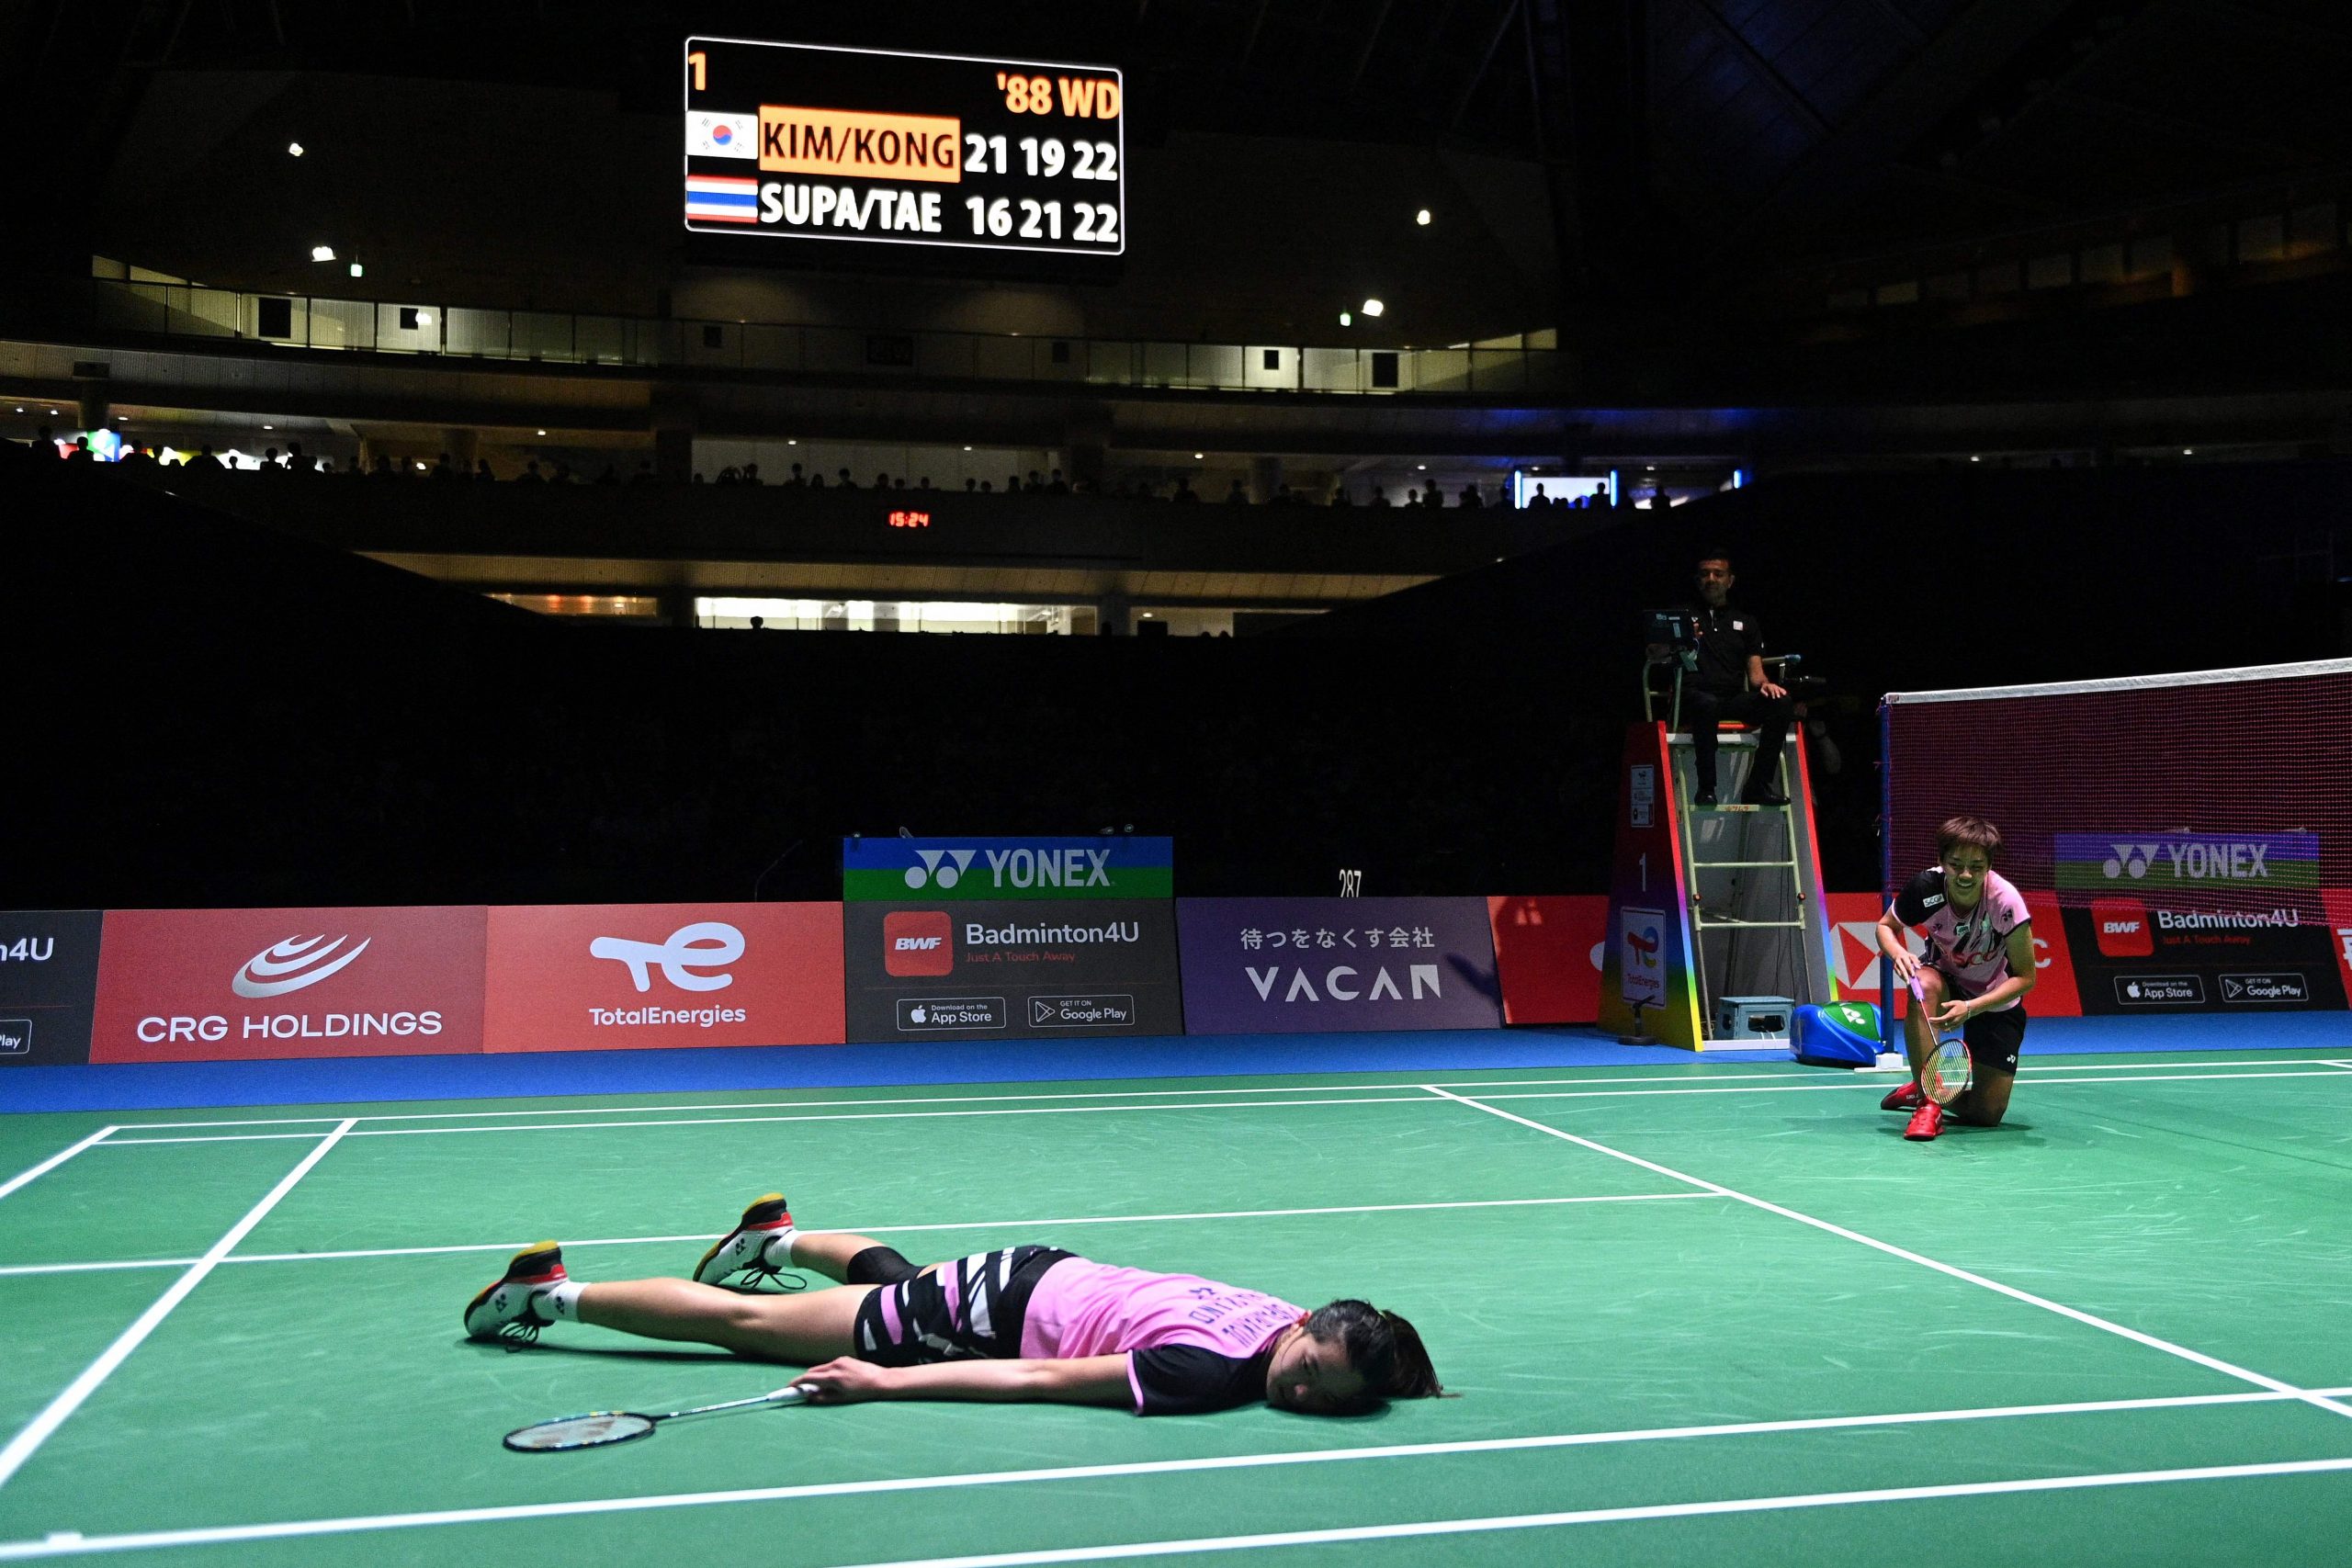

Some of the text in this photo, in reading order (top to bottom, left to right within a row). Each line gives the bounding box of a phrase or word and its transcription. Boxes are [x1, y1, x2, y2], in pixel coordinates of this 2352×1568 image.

[689, 52, 707, 91] 1
[997, 73, 1120, 119] '88 WD
[763, 122, 1118, 181] KIM/KONG 21 19 22
[760, 184, 1118, 243] SUPA/TAE 16 21 22
[889, 512, 930, 527] 15:24
[986, 849, 1111, 887] YONEX
[2167, 843, 2268, 878] YONEX
[1339, 869, 1362, 897] 287
[1639, 852, 1646, 892] 1
[2104, 922, 2140, 933] BWF
[2157, 909, 2299, 929] Badminton4U
[895, 938, 942, 950] BWF
[967, 922, 1139, 944] Badminton4U
[1240, 927, 1436, 950] 待つをなくす会社
[967, 952, 1076, 963] Just A Touch Away
[1245, 964, 1442, 1002] VACAN
[2144, 987, 2193, 999] App Store
[2246, 985, 2301, 998] Google Play
[589, 1006, 746, 1028] TotalEnergies
[932, 1011, 992, 1024] App Store
[1060, 1008, 1126, 1021] Google Play
[137, 1011, 443, 1042] CRG HOLDINGS
